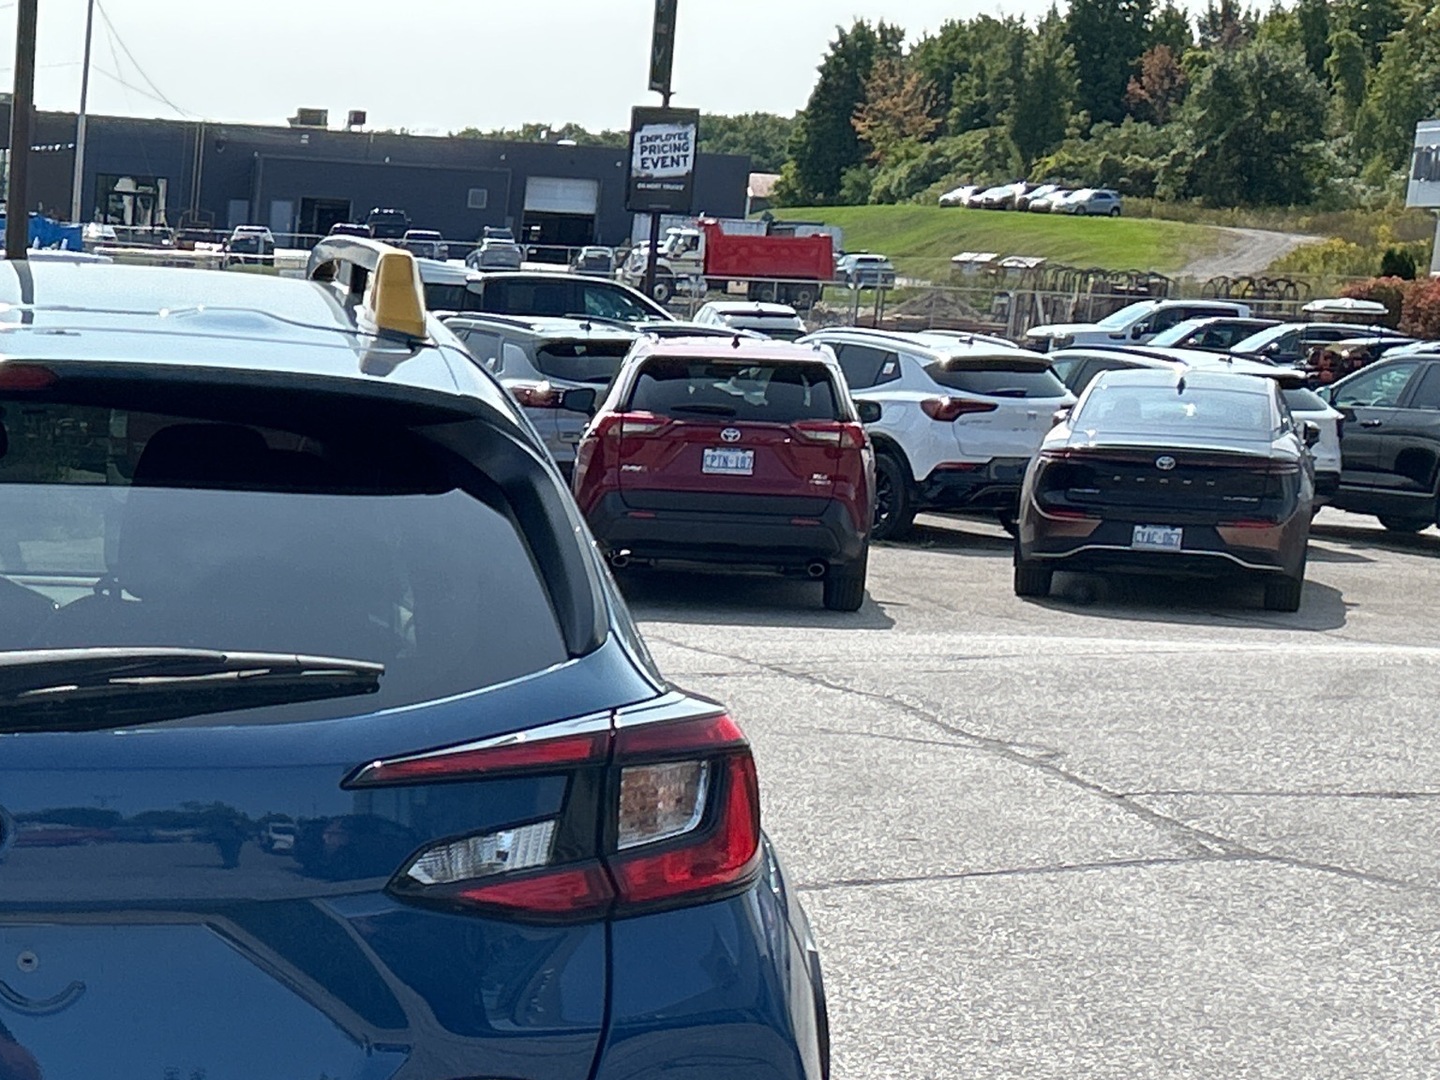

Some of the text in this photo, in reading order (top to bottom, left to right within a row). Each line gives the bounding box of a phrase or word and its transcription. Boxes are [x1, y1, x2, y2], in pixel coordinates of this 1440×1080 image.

[640, 132, 690, 144] EMPLOYEE
[640, 142, 690, 156] PRICING
[641, 154, 690, 170] EVENT
